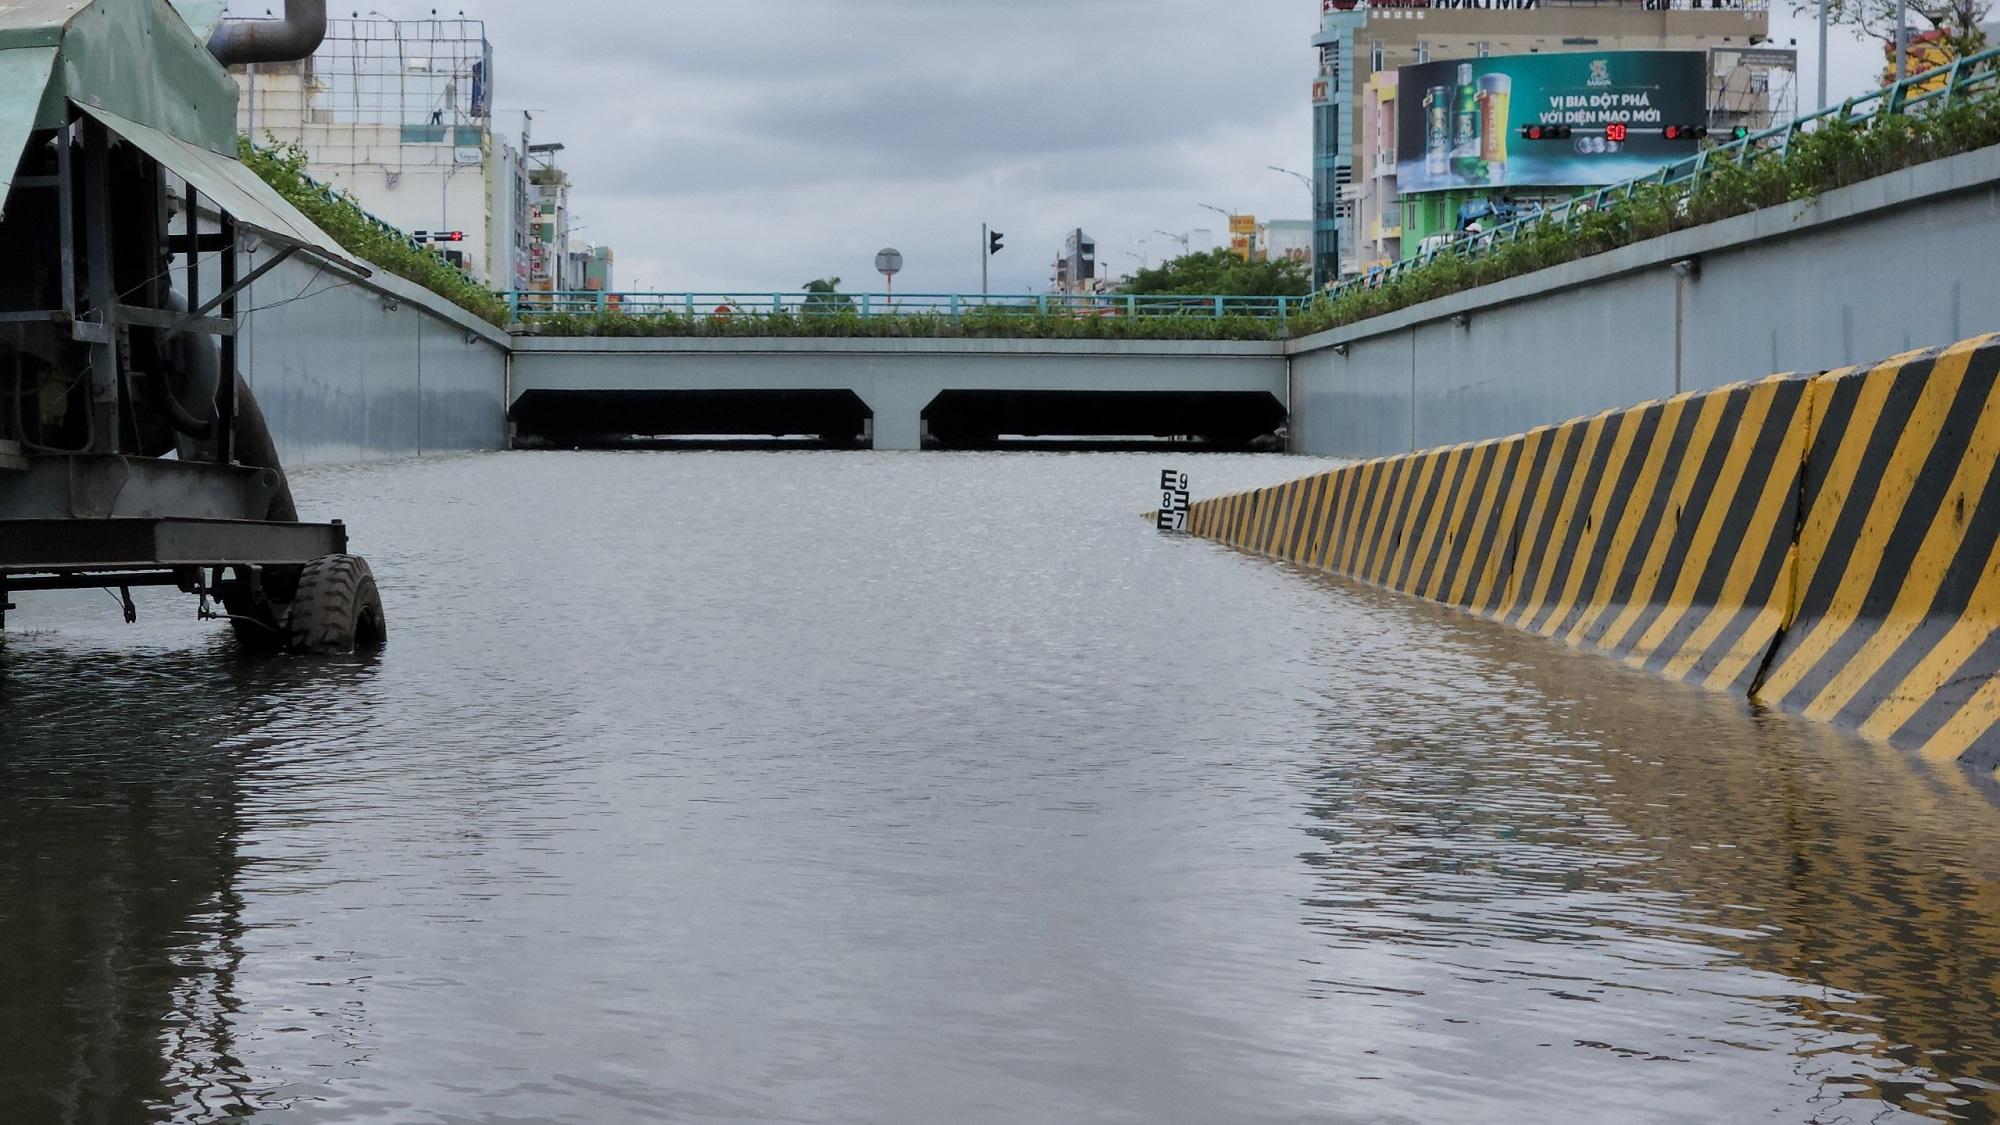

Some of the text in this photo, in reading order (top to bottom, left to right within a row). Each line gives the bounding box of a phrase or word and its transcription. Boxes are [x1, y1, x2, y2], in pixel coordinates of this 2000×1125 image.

[1550, 92, 1650, 110] VỊ BIA ĐỘT PHÁ
[1539, 110, 1563, 123] VỚI
[1565, 109, 1596, 126] DIỆN
[1632, 107, 1661, 122] MỚI
[1606, 124, 1626, 140] 50
